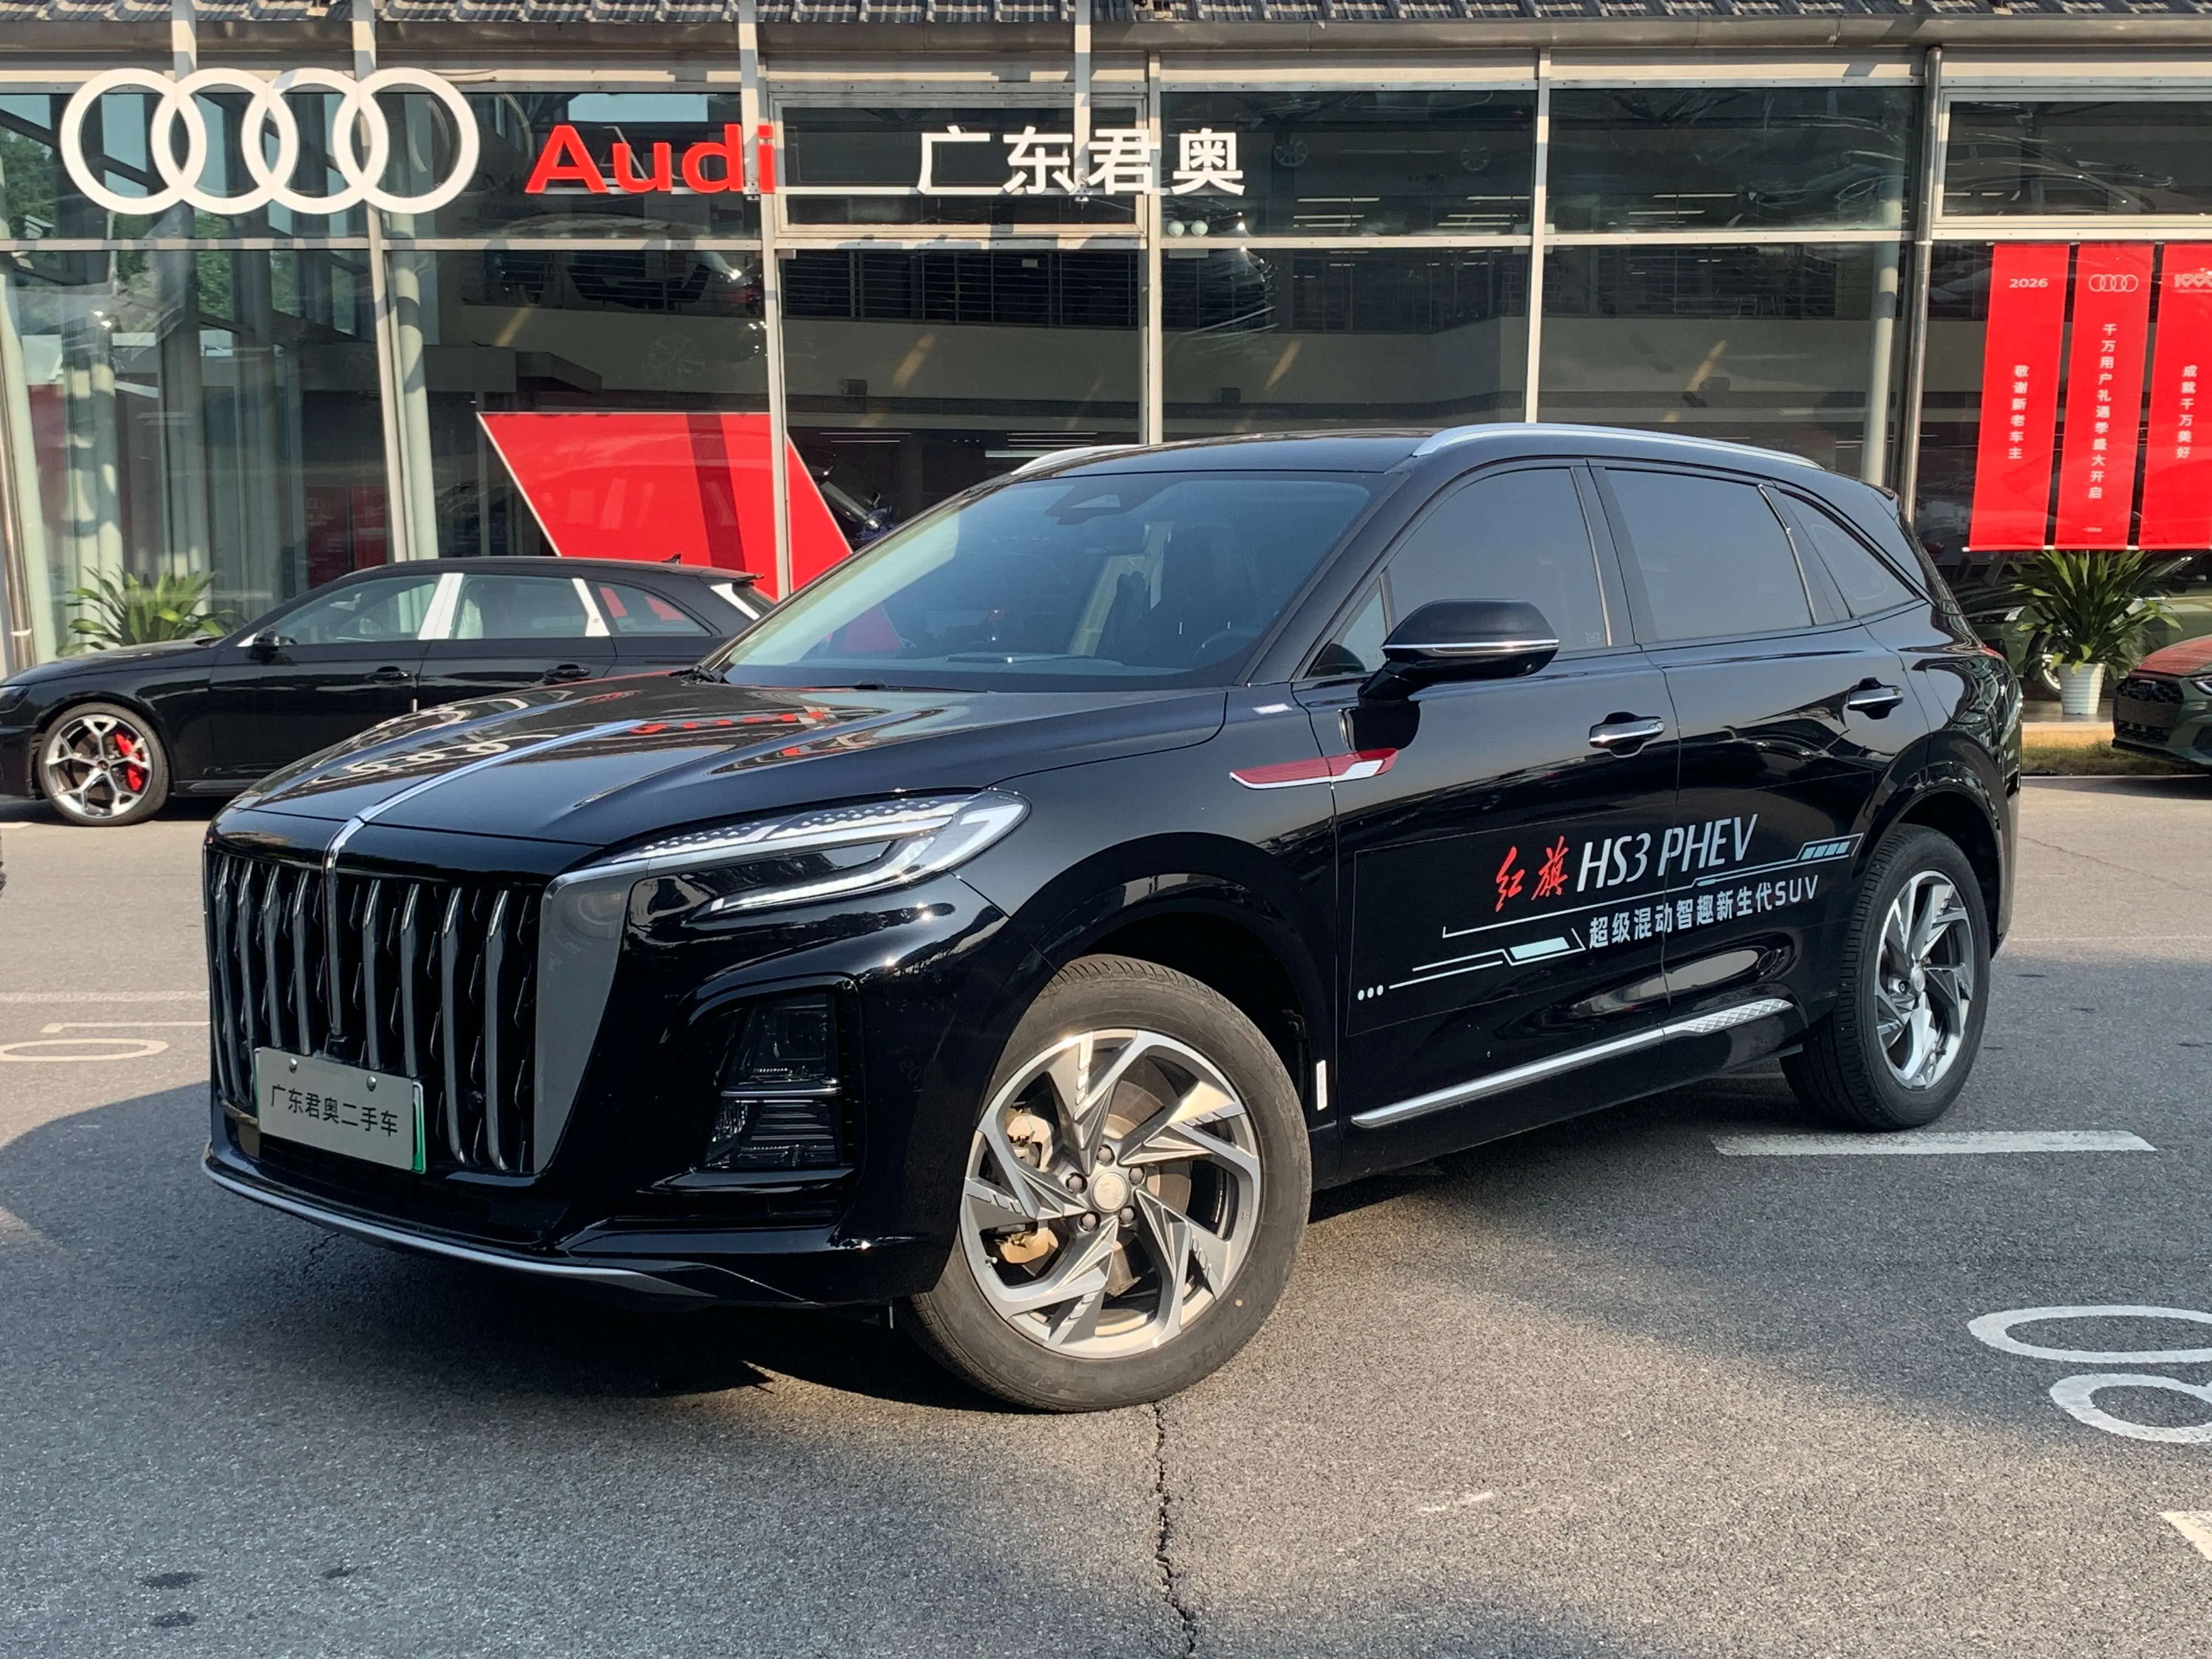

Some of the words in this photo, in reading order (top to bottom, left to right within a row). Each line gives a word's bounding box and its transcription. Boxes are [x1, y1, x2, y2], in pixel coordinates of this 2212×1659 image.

[524, 124, 776, 193] Audi
[917, 125, 1245, 195] 广东君奥
[2009, 278, 2049, 288] 2026
[2176, 364, 2198, 459] 成就千万美好
[1496, 835, 1570, 912] 红旗
[1576, 833, 1651, 892] HS3
[1657, 815, 1757, 877] PHEV
[1589, 875, 1819, 950] 超级混动智趣新生代SUV
[271, 1084, 398, 1137] 广东君奥二手车
